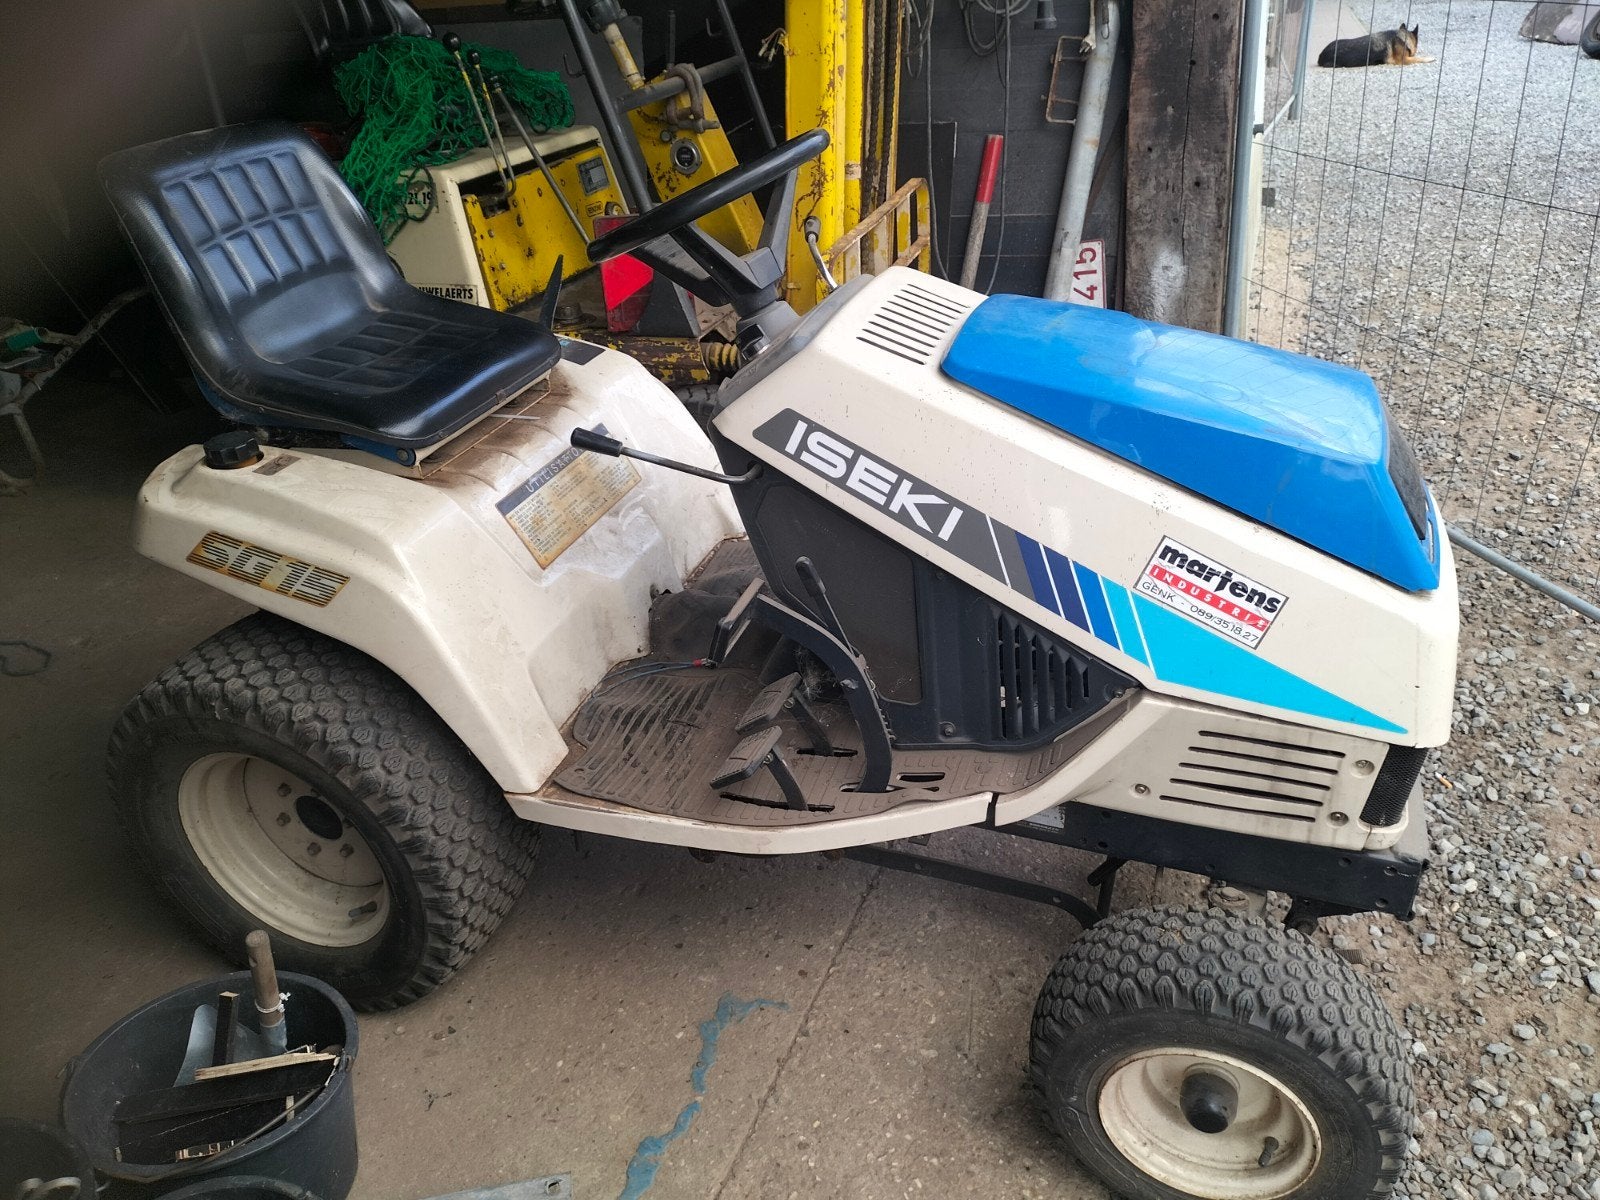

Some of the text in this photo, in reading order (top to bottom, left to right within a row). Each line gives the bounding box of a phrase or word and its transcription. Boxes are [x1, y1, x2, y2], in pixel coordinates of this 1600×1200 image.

[1073, 247, 1098, 301] 415
[525, 445, 586, 493] UTILISATIO
[785, 419, 964, 542] ISEKI
[1152, 568, 1267, 628] INDUSTRIE
[1158, 544, 1282, 614] martens
[1142, 581, 1177, 603] GENK
[1190, 605, 1260, 643] 089/35.18.27
